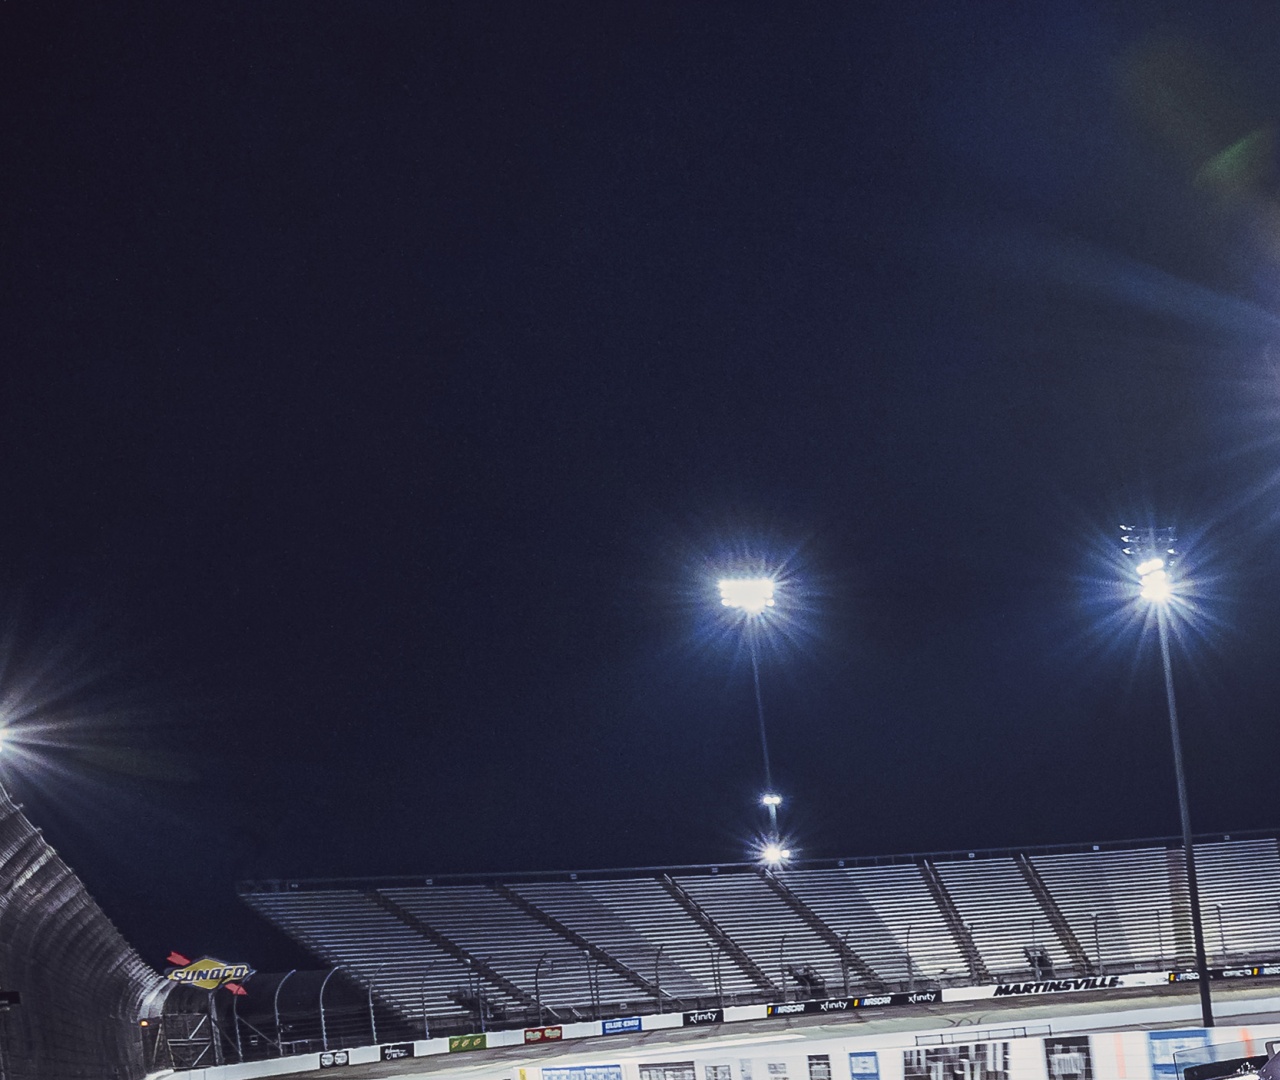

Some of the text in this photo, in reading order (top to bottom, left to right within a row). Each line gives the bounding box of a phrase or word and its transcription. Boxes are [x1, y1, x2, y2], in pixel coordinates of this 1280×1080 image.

[173, 966, 246, 981] SUNOCO
[993, 976, 1120, 996] MARTINSVILLE
[777, 993, 936, 1013] NASCAR xfinity NASCAR xfinity
[690, 1012, 717, 1023] xfinity
